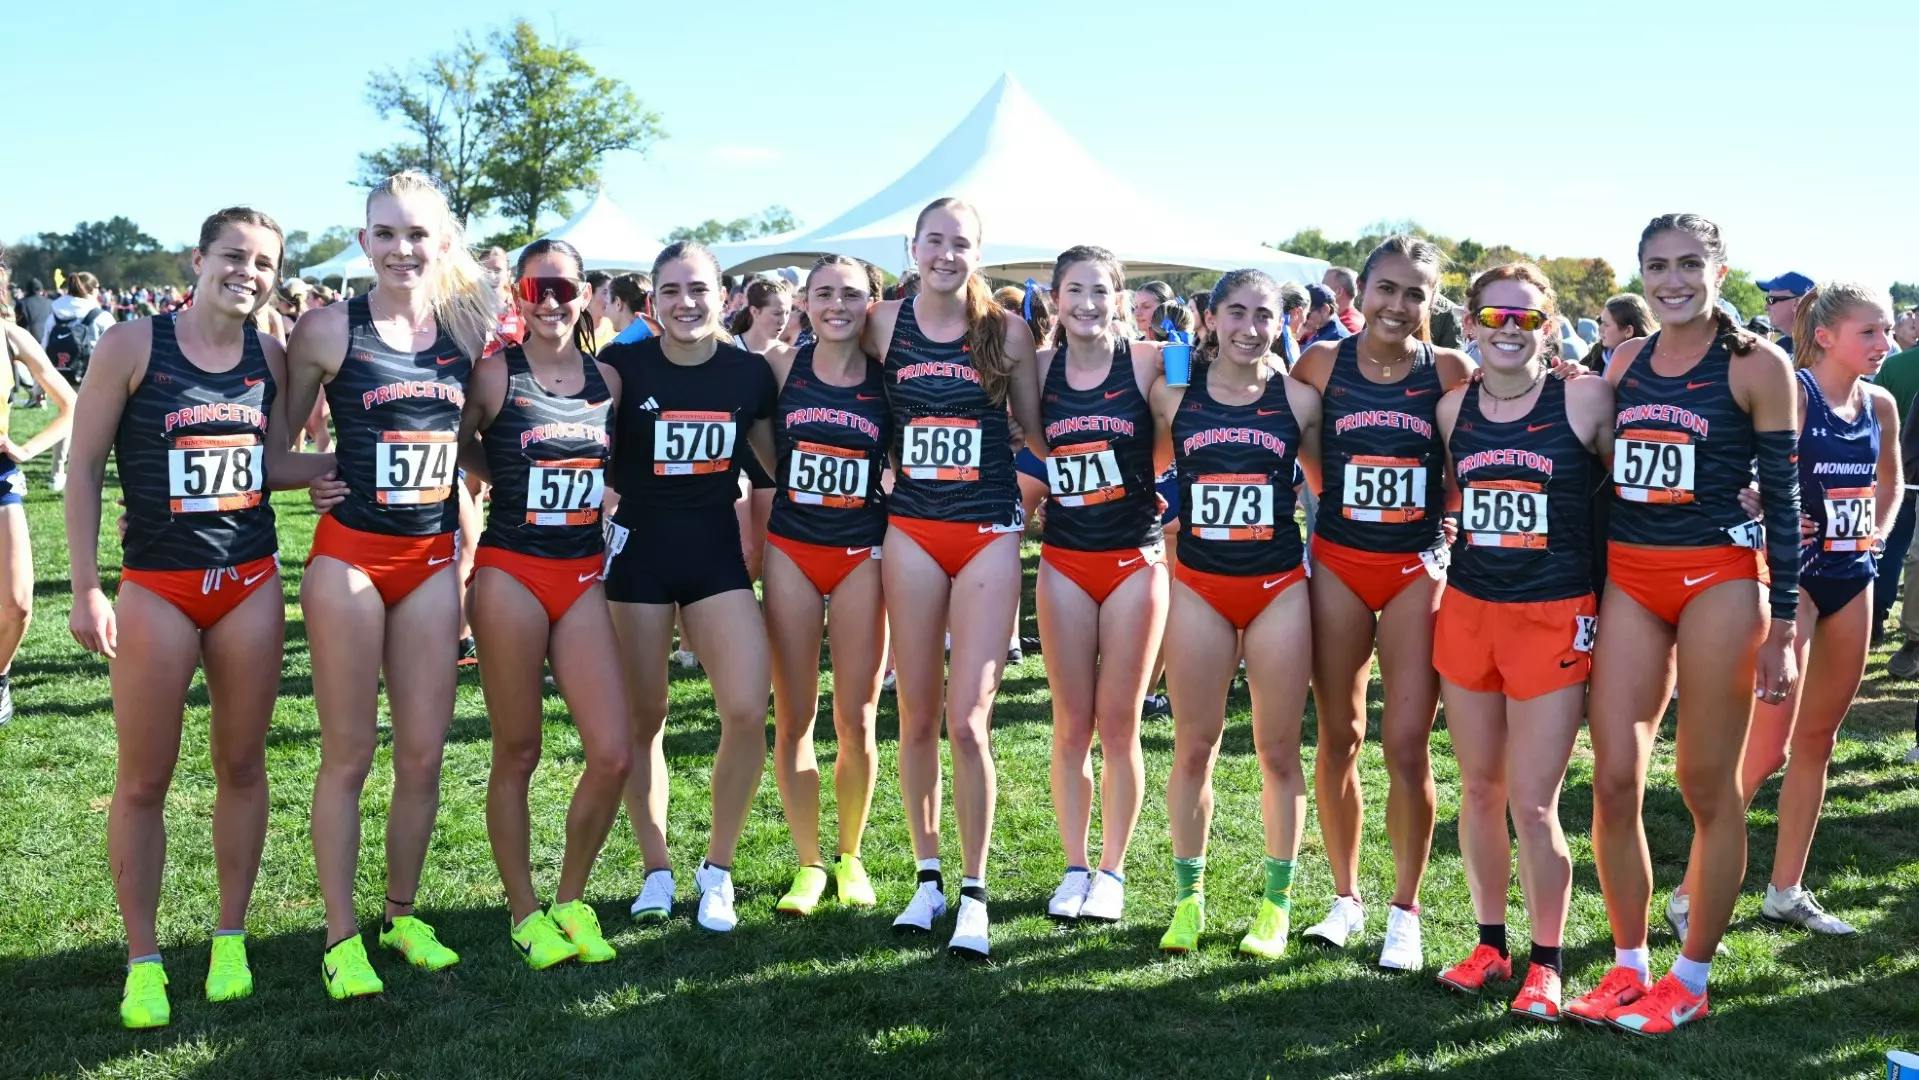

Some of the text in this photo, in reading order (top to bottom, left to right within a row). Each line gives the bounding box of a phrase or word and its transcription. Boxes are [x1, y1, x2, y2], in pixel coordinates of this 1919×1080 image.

[165, 403, 269, 434] PRINCETON
[786, 407, 880, 441] PRINCETON
[1045, 416, 1134, 442] PRINCETON
[1336, 411, 1432, 439] PRINCETON
[1615, 403, 1709, 437] PRINCETON
[666, 422, 725, 461] 570
[911, 428, 973, 466] 568
[1183, 428, 1286, 458] PRINCETON
[184, 448, 253, 496] 578
[389, 444, 448, 487] 574
[797, 453, 860, 495] 580
[1056, 454, 1111, 493] 571
[1457, 449, 1553, 477] PRINCETON
[1624, 441, 1683, 488] 579
[540, 469, 594, 509] 572
[1201, 485, 1262, 525] 573
[1354, 467, 1417, 507] 581
[1471, 490, 1537, 532] 569
[1832, 499, 1872, 537] 525
